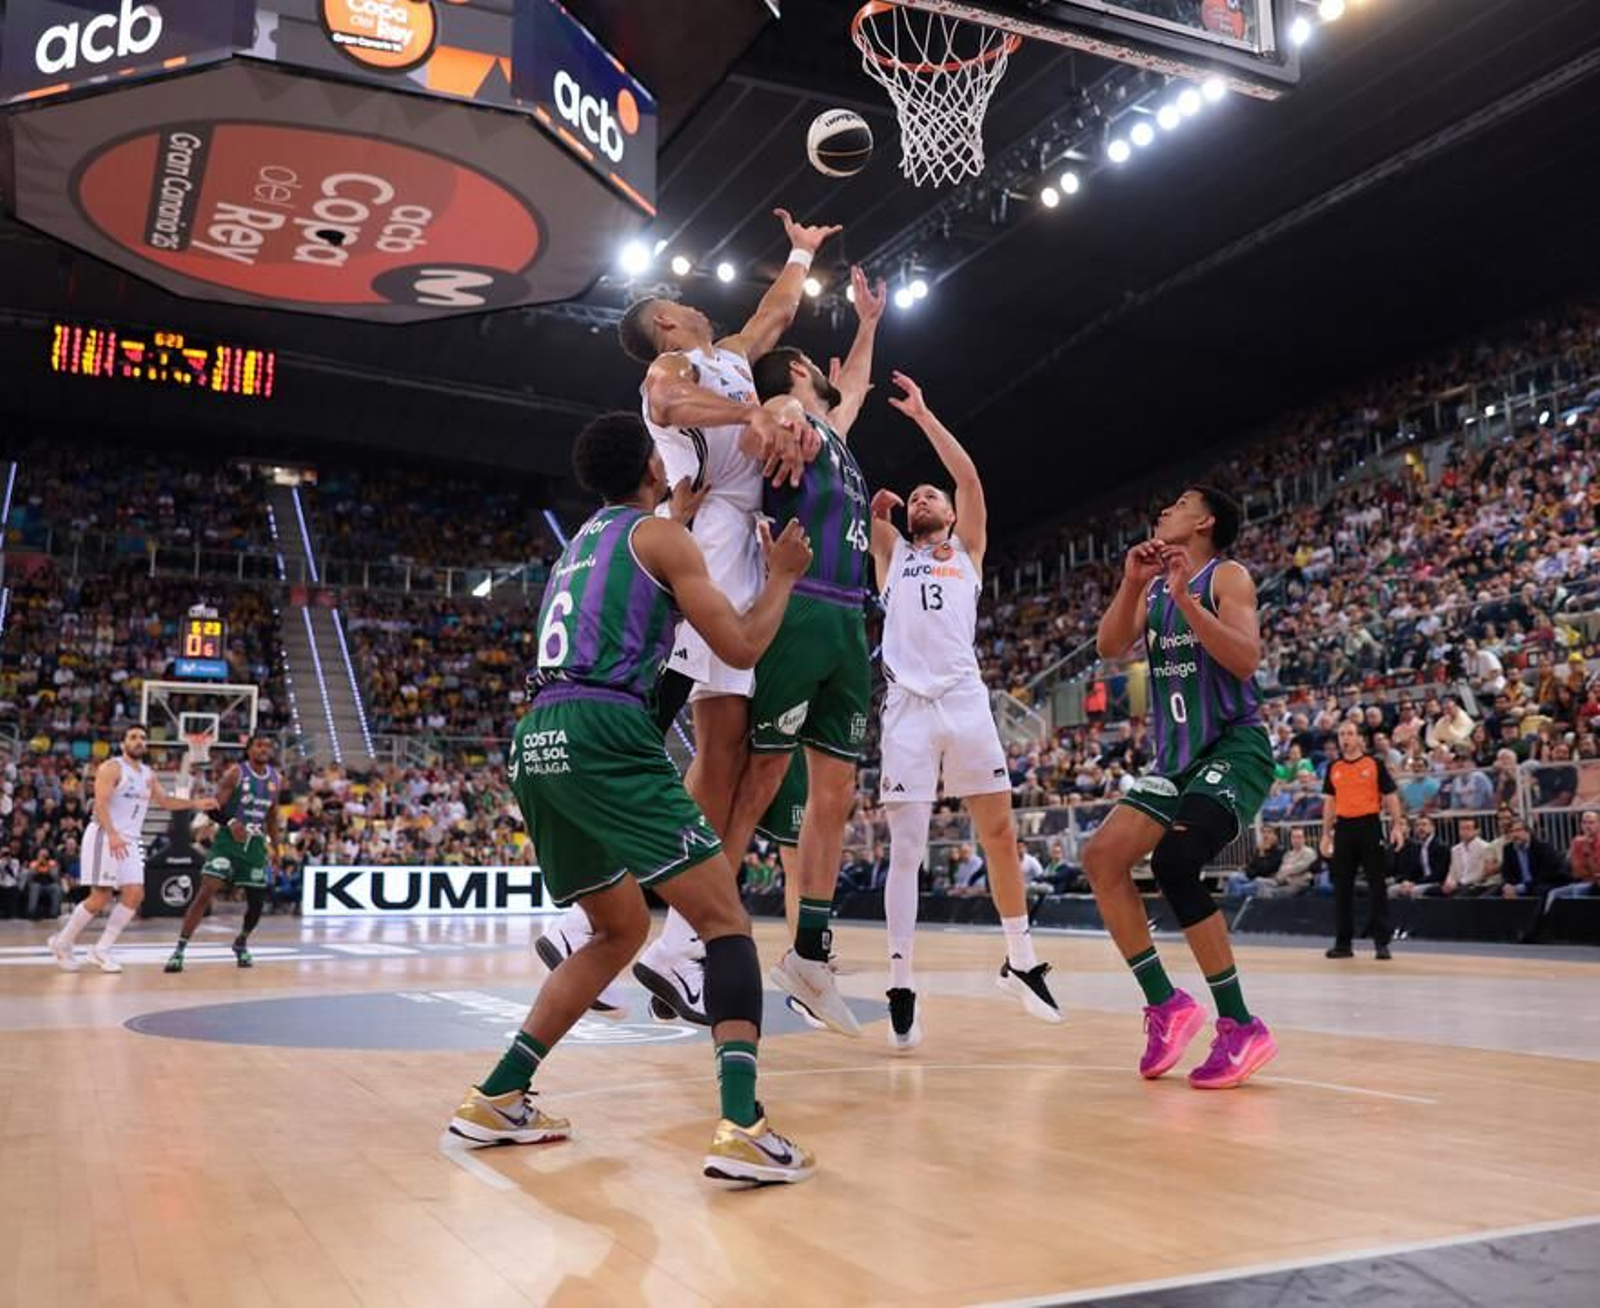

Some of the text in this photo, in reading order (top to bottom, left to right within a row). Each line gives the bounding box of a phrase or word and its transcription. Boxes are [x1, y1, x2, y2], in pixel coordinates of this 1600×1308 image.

[35, 0, 162, 74] acb
[553, 70, 624, 162] acb
[164, 132, 202, 177] Gran
[253, 165, 303, 209] del
[190, 202, 287, 265] Rey
[292, 173, 395, 267] Copa
[376, 204, 433, 253] acb
[845, 519, 869, 552] 45
[920, 583, 943, 611] 13
[537, 590, 574, 668] 6
[1170, 691, 1188, 724] 0
[522, 746, 569, 764] DEL SOL
[523, 729, 568, 749] COSTA
[313, 871, 544, 911] KUMH
